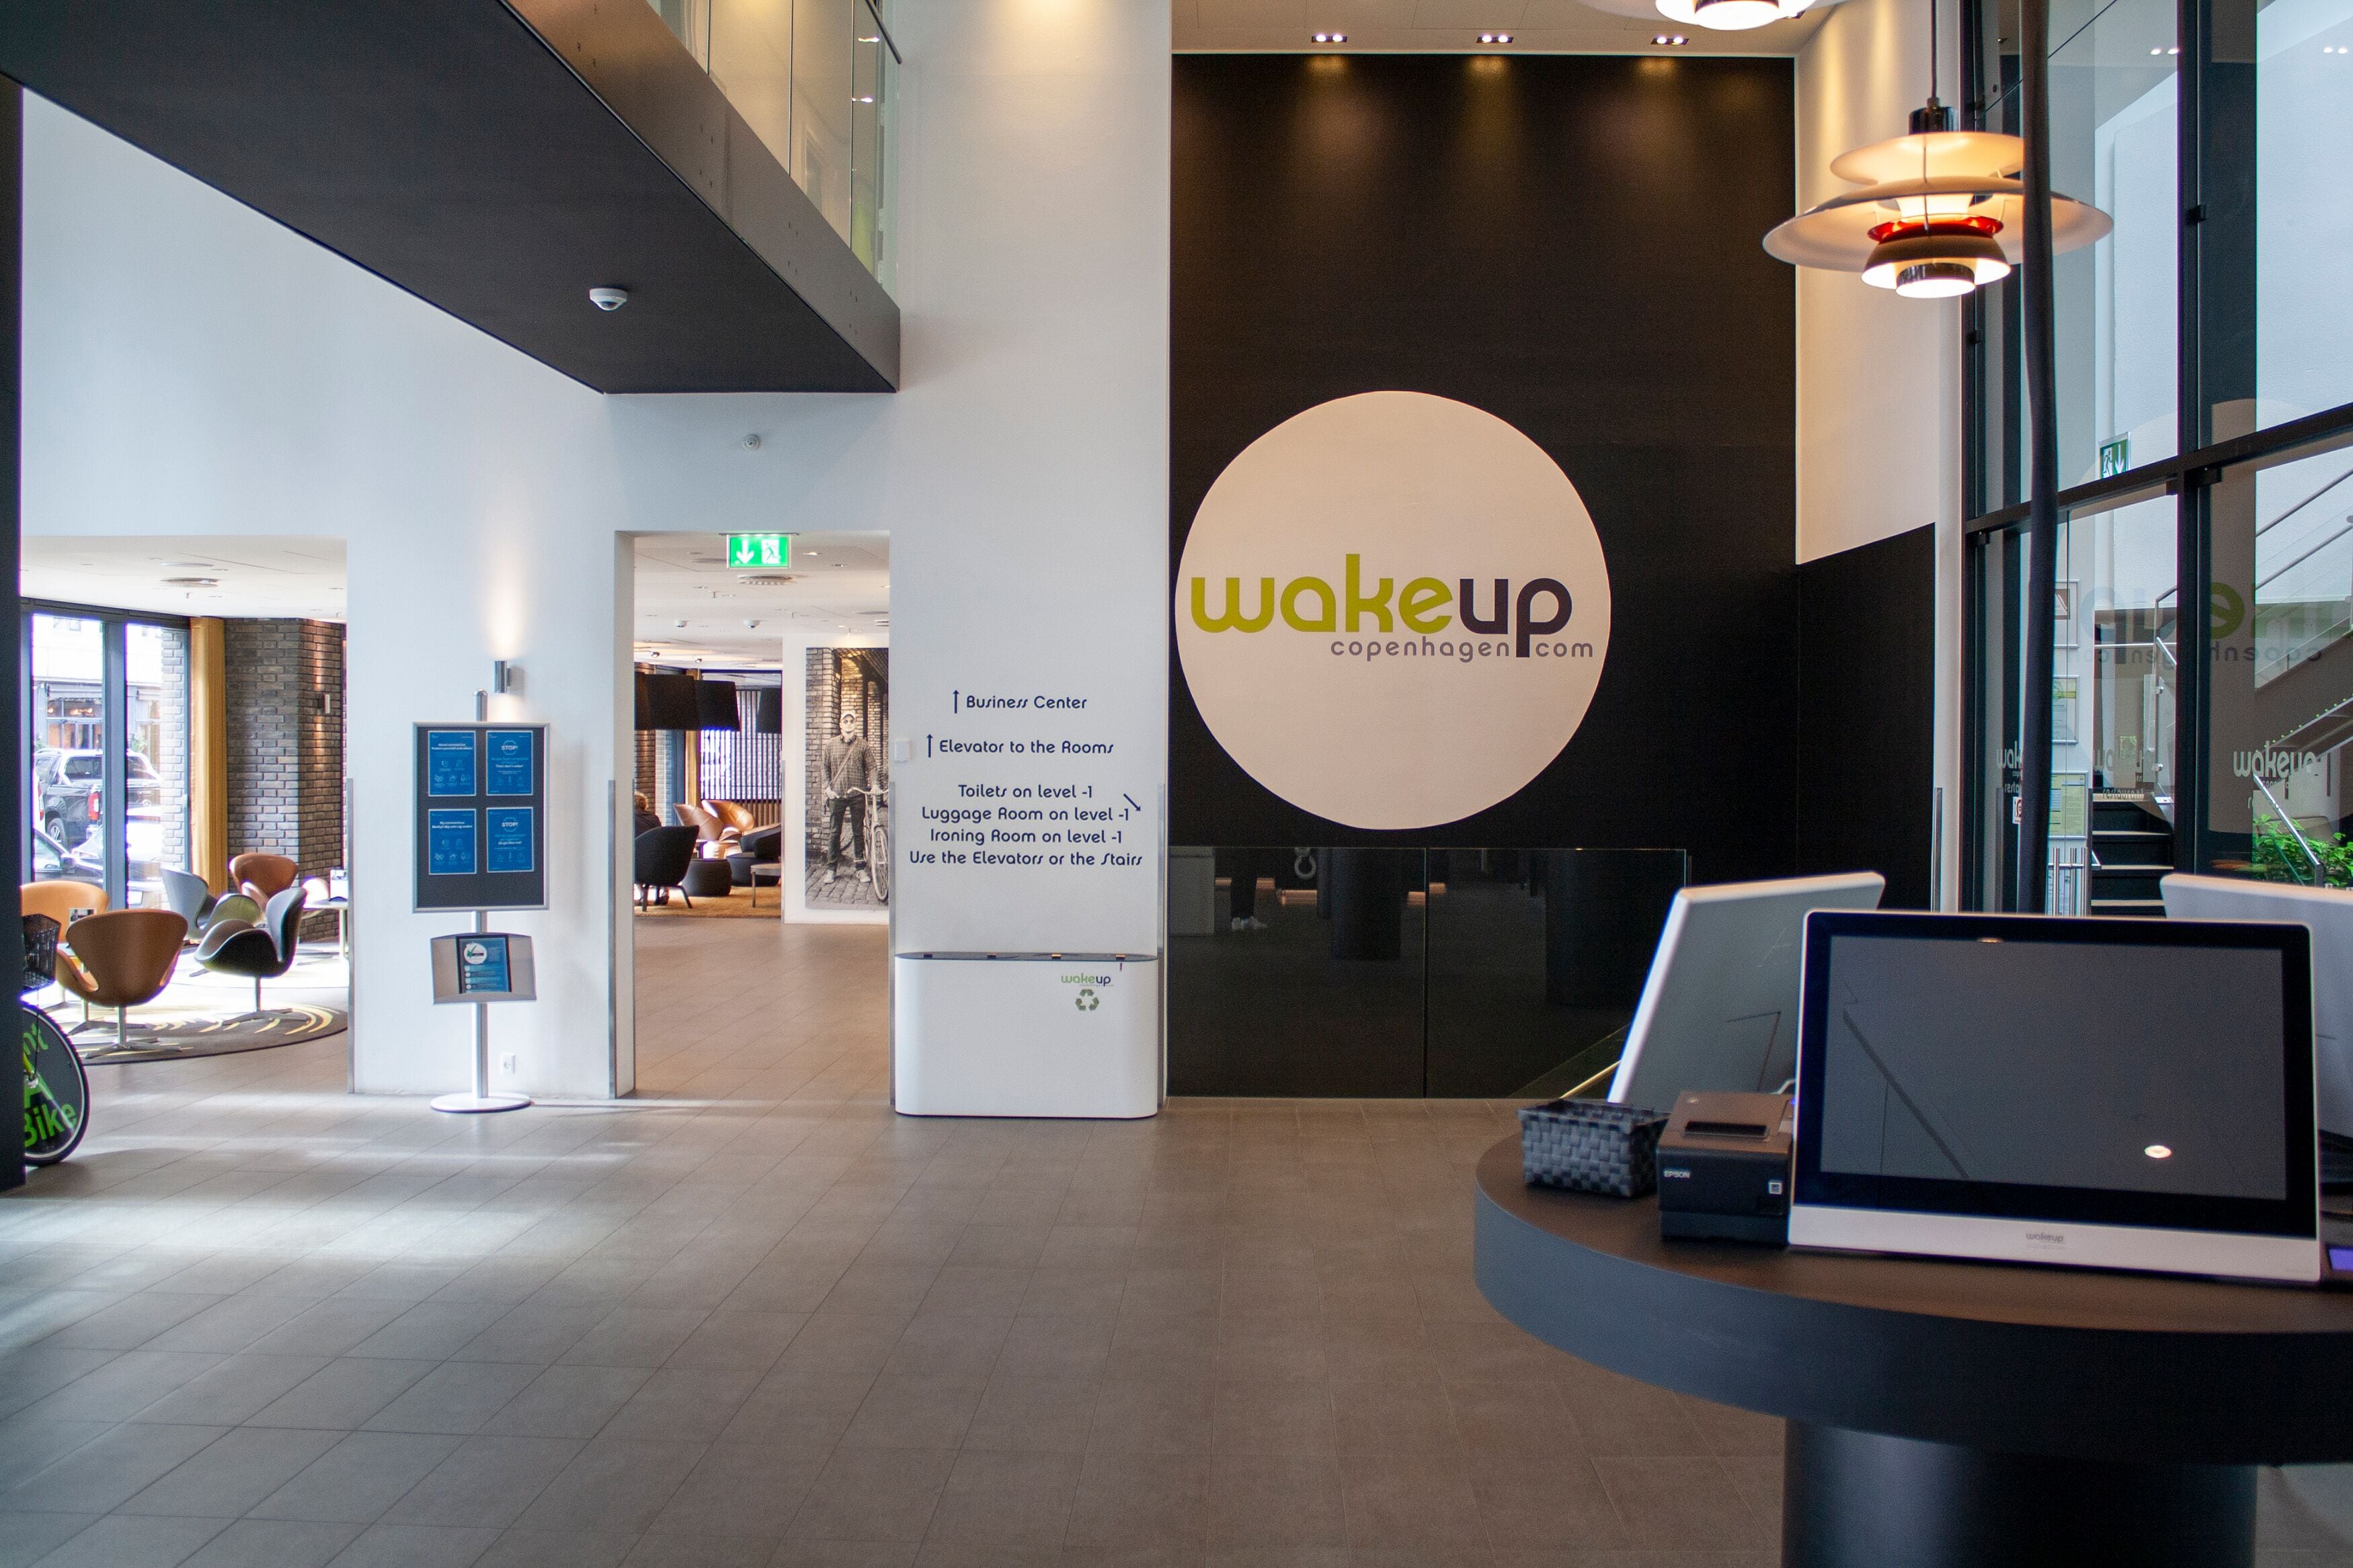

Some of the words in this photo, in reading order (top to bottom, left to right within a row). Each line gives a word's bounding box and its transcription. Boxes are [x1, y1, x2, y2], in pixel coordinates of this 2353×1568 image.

[1191, 553, 1573, 659] wakeup
[966, 695, 1029, 709] Business
[1033, 695, 1087, 710] Center
[939, 739, 1004, 754] Elevator
[1010, 740, 1025, 753] to
[1031, 739, 1055, 753] the
[1062, 740, 1114, 754] Rooms
[957, 784, 1007, 798] Toilets
[1012, 788, 1032, 798] on
[1038, 784, 1076, 798] level
[1082, 785, 1093, 798] -1
[922, 806, 992, 824] Luggage
[998, 807, 1043, 821] Room
[1049, 811, 1068, 821] on
[1074, 807, 1113, 821] level
[1118, 808, 1129, 821] -1
[930, 828, 985, 846] Ironing
[991, 829, 1036, 843] Room
[1041, 833, 1062, 843] on
[1068, 829, 1106, 843] level
[1111, 831, 1122, 843] -1
[910, 850, 936, 864] Use
[942, 850, 967, 864] the
[973, 850, 1043, 865] Elevators
[1048, 855, 1065, 865] or
[1070, 852, 1095, 866] the
[1101, 852, 1143, 866] Stairs
[1061, 973, 1111, 987] wakeup
[24, 1103, 78, 1148] Bike
[1663, 1171, 1691, 1179] EPSON
